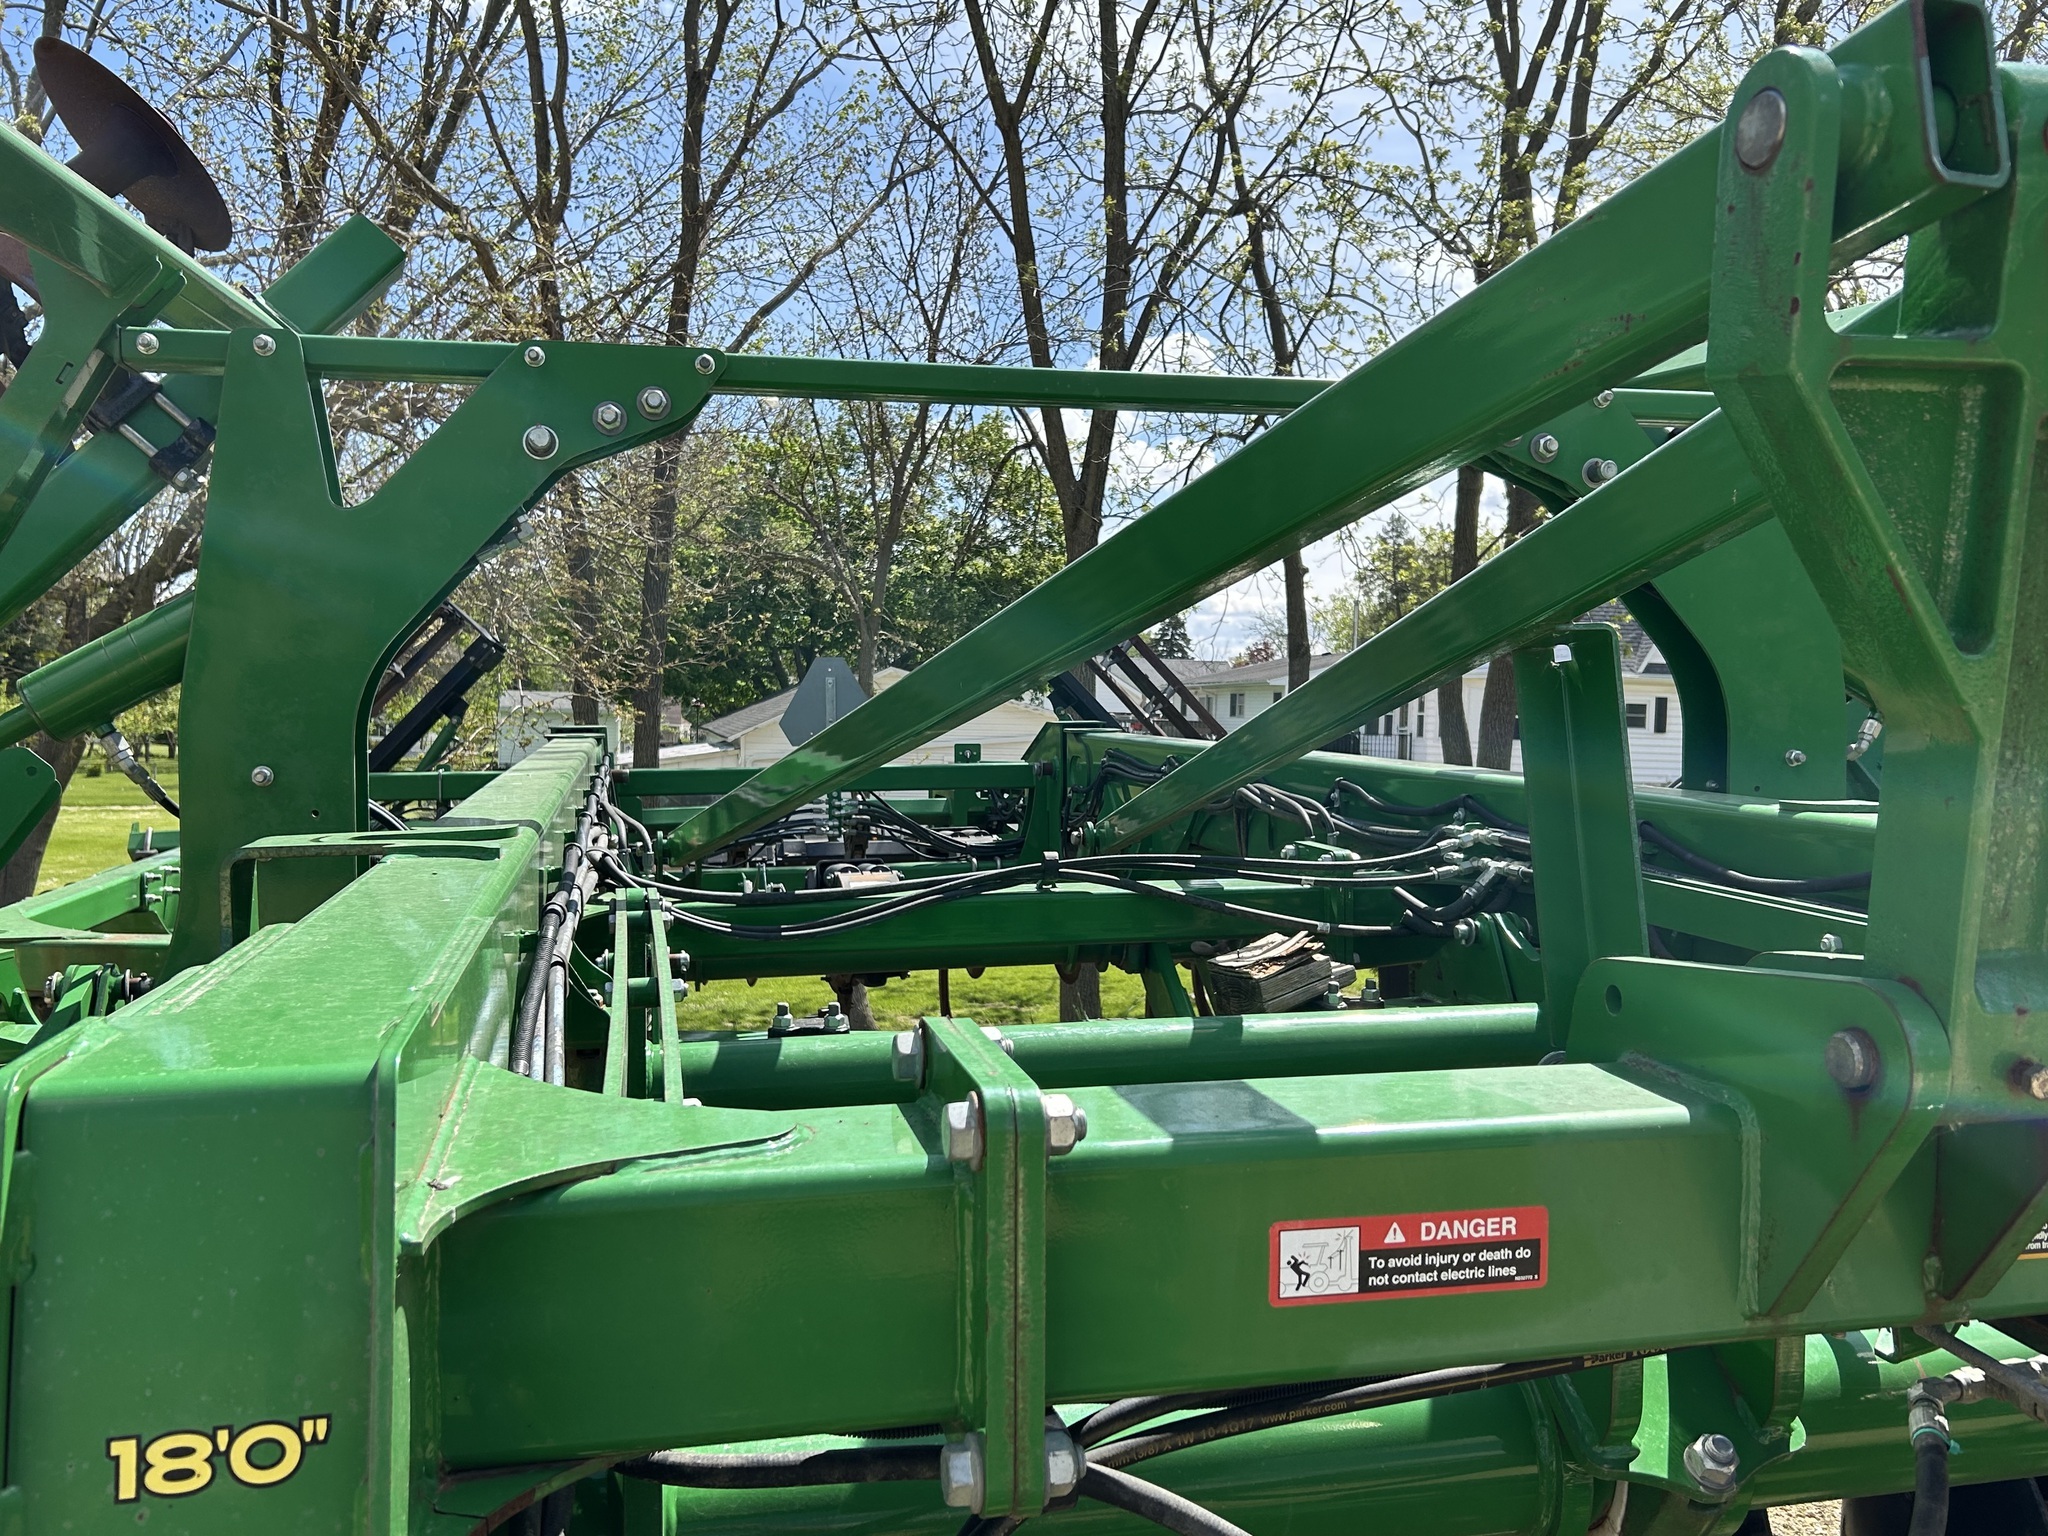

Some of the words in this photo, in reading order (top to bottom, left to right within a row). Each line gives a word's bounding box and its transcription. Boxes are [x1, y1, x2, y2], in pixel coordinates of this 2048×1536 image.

[1420, 1216, 1517, 1241] DANGER
[1368, 1256, 1385, 1269] To
[1388, 1252, 1422, 1268] avoid
[1425, 1251, 1460, 1268] injury
[1462, 1251, 1476, 1263] or
[1478, 1248, 1512, 1261] death
[1515, 1246, 1532, 1259] do
[2025, 1242, 2041, 1250] rom
[1368, 1273, 1389, 1286] not
[1391, 1270, 1438, 1285] contact
[1440, 1266, 1486, 1281] electric
[1488, 1265, 1517, 1278] lines
[1261, 1401, 1348, 1424] www.parker.com
